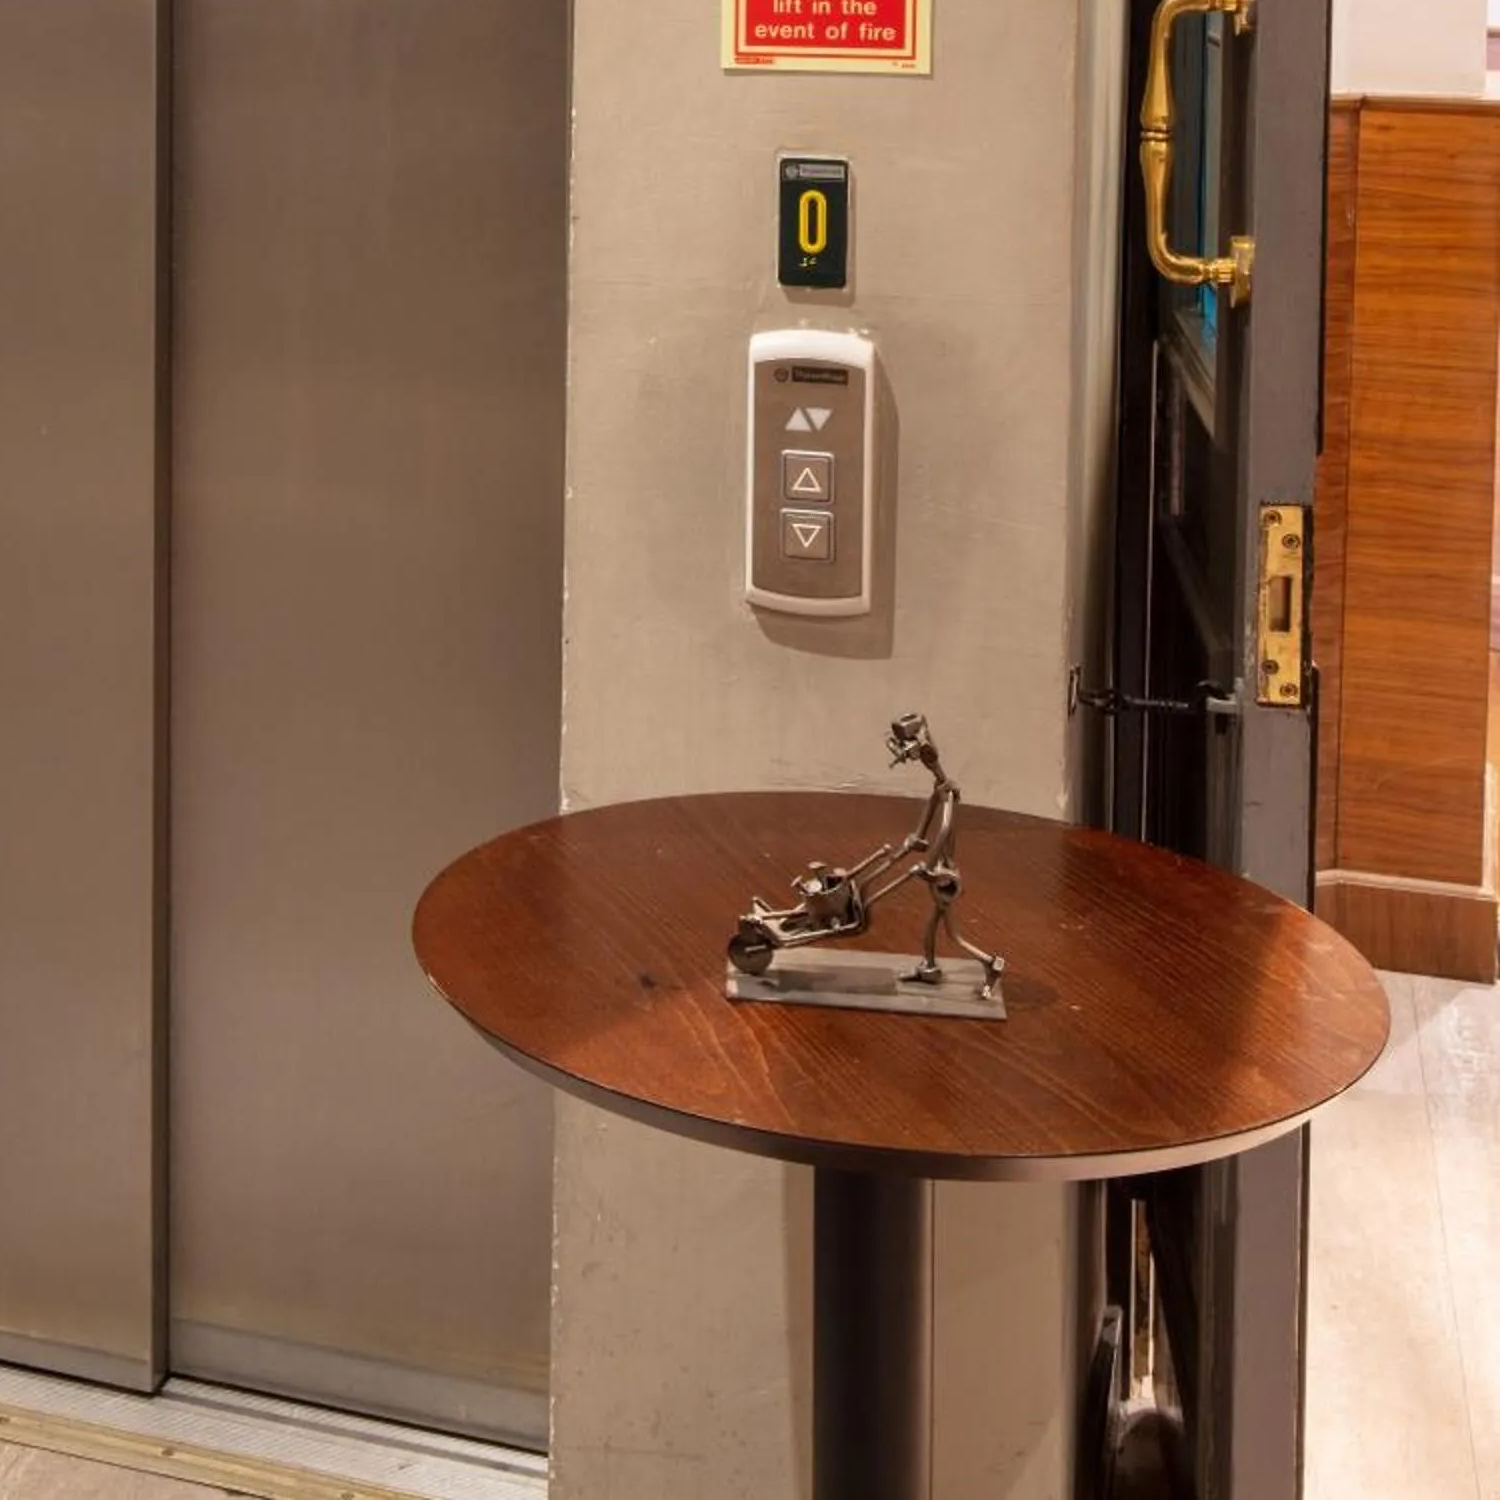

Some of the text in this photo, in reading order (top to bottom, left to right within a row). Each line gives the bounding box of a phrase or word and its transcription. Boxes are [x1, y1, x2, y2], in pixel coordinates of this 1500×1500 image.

[755, 23, 897, 42] event of fire
[799, 190, 827, 255] 0
